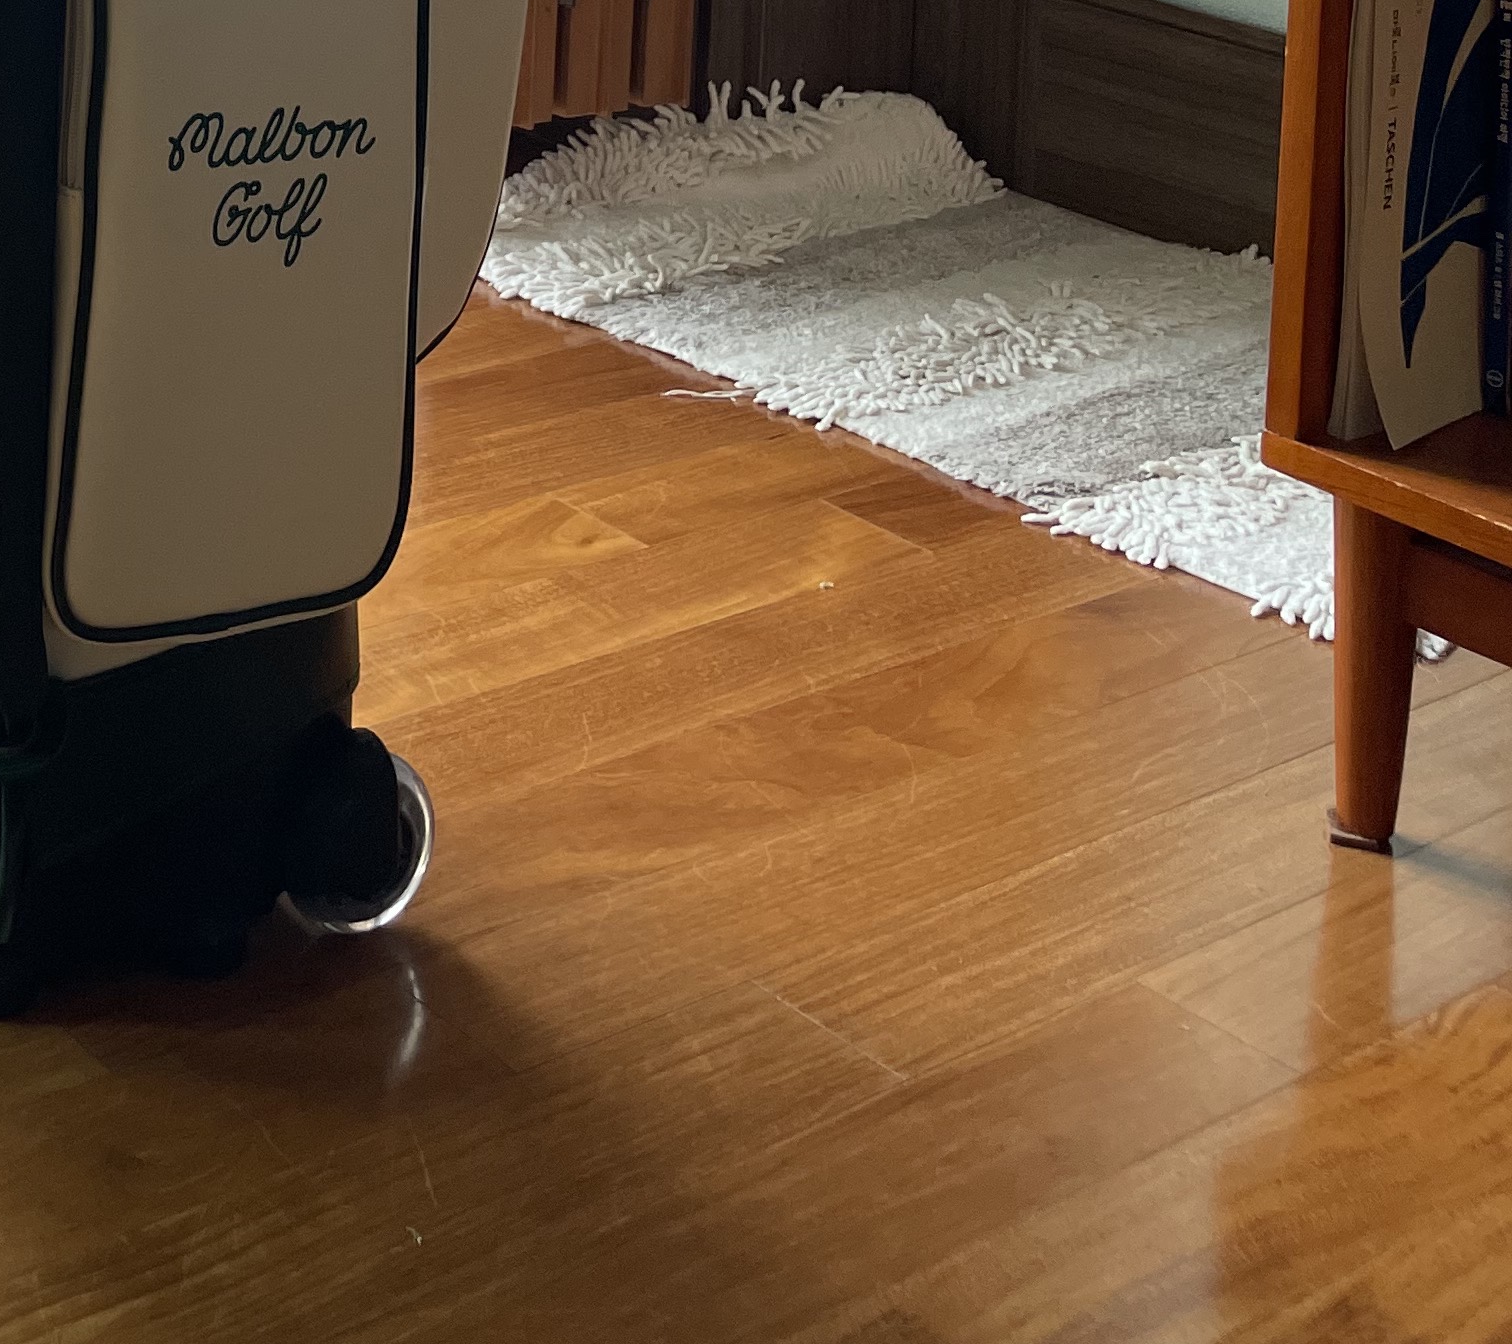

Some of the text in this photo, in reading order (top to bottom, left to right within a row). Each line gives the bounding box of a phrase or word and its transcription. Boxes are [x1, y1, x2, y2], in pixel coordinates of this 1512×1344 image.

[168, 105, 376, 171] Malbon
[1382, 117, 1397, 211] TASCHEN
[213, 173, 328, 268] Golf
